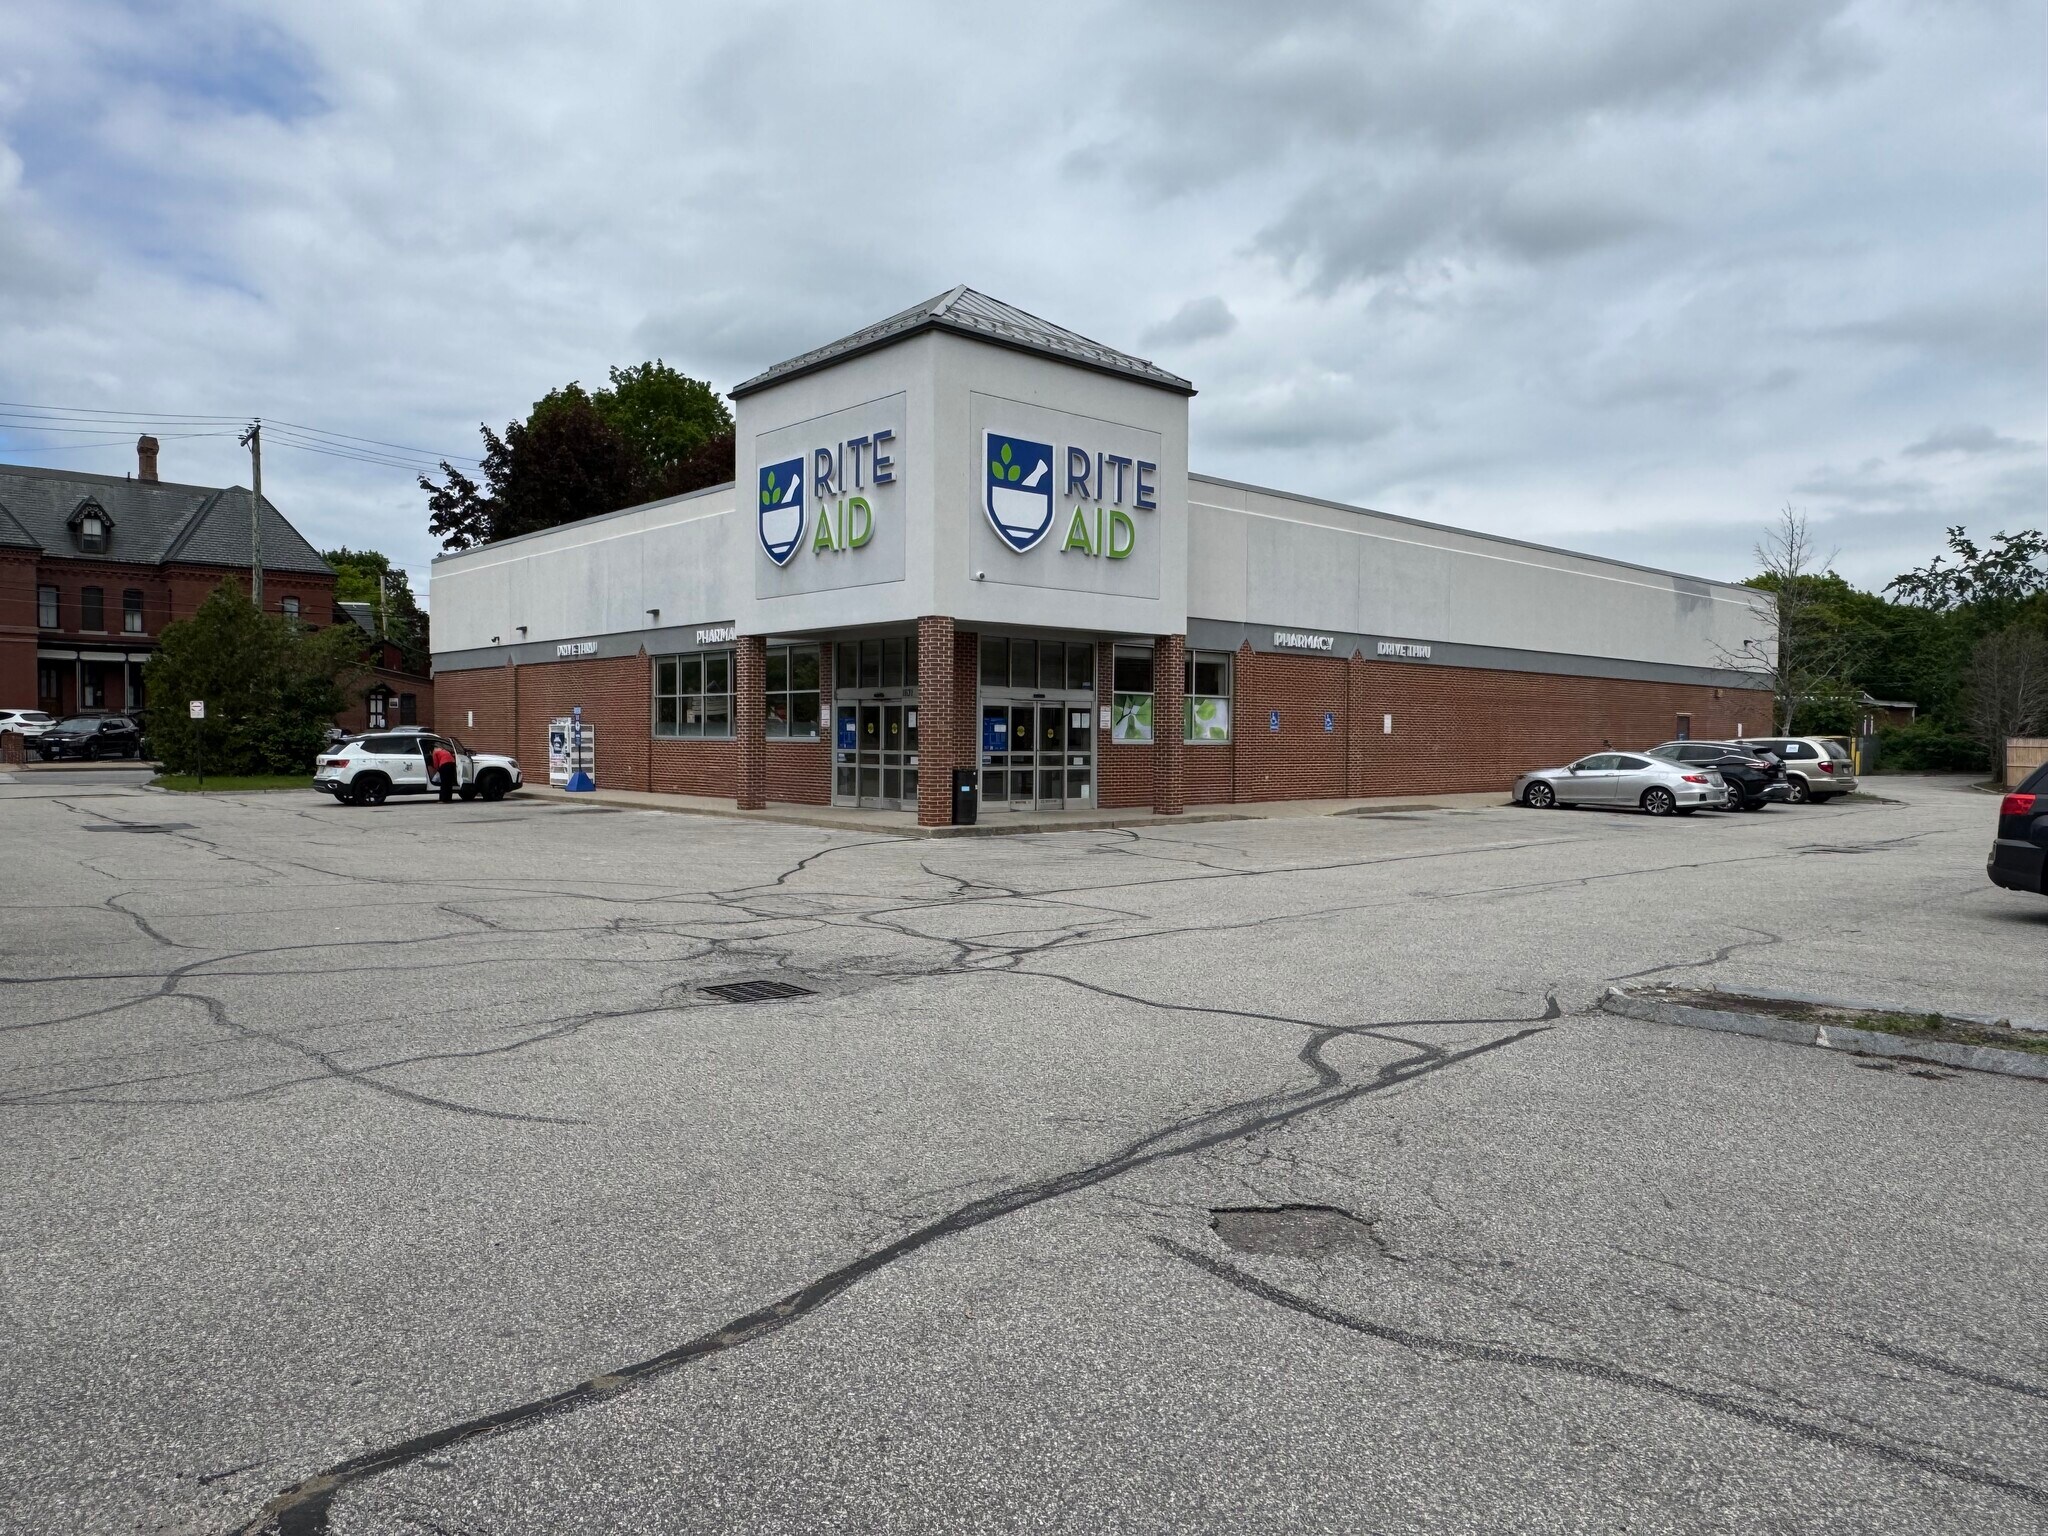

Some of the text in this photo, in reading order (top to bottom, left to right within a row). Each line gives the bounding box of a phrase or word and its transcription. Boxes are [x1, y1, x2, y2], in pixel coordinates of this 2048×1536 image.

[814, 429, 896, 498] RITE
[1064, 446, 1157, 510] RITE
[812, 496, 875, 554] AID
[1060, 504, 1136, 559] AID
[696, 627, 736, 645] PHARMA
[1273, 632, 1334, 650] PHARMACY
[1377, 642, 1431, 658] DRIVE THRU
